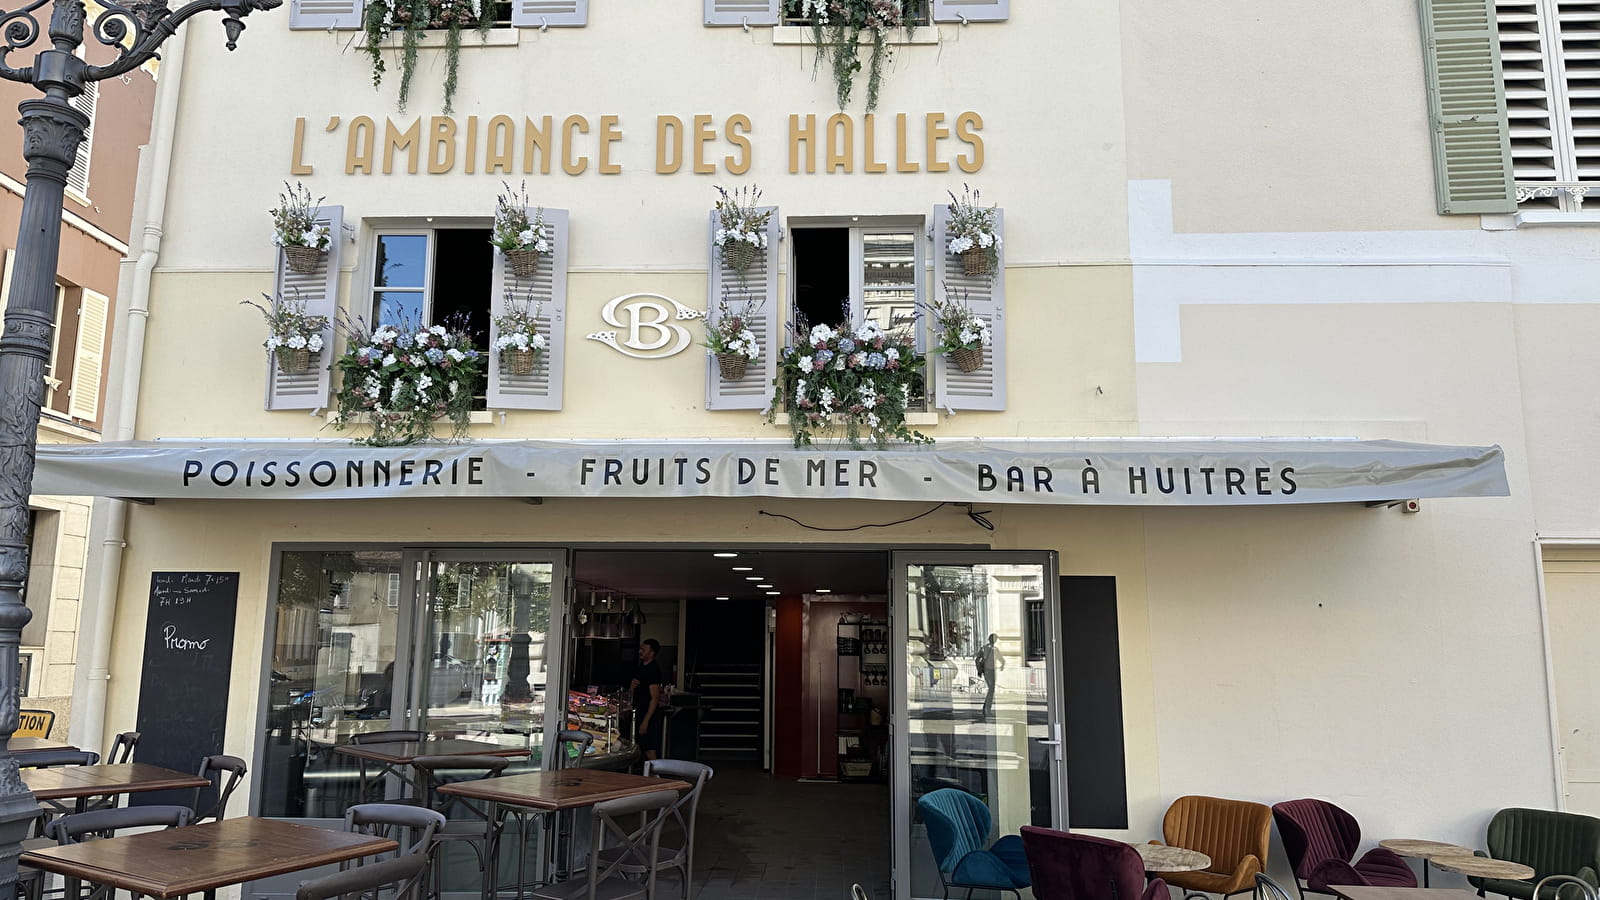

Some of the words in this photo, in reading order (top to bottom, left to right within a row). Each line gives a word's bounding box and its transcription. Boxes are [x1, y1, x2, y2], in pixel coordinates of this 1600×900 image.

[290, 114, 623, 176] L'AMBIANCE
[656, 113, 752, 175] DES
[789, 111, 985, 174] HALLES
[183, 457, 484, 488] POISSONNERIE
[580, 458, 711, 486] FRUITS
[737, 457, 780, 486] DE
[806, 458, 879, 488] MER
[977, 463, 1054, 493] BAR
[1081, 458, 1101, 494] À
[1128, 466, 1298, 496] HUITRES
[163, 624, 210, 651] Promo
